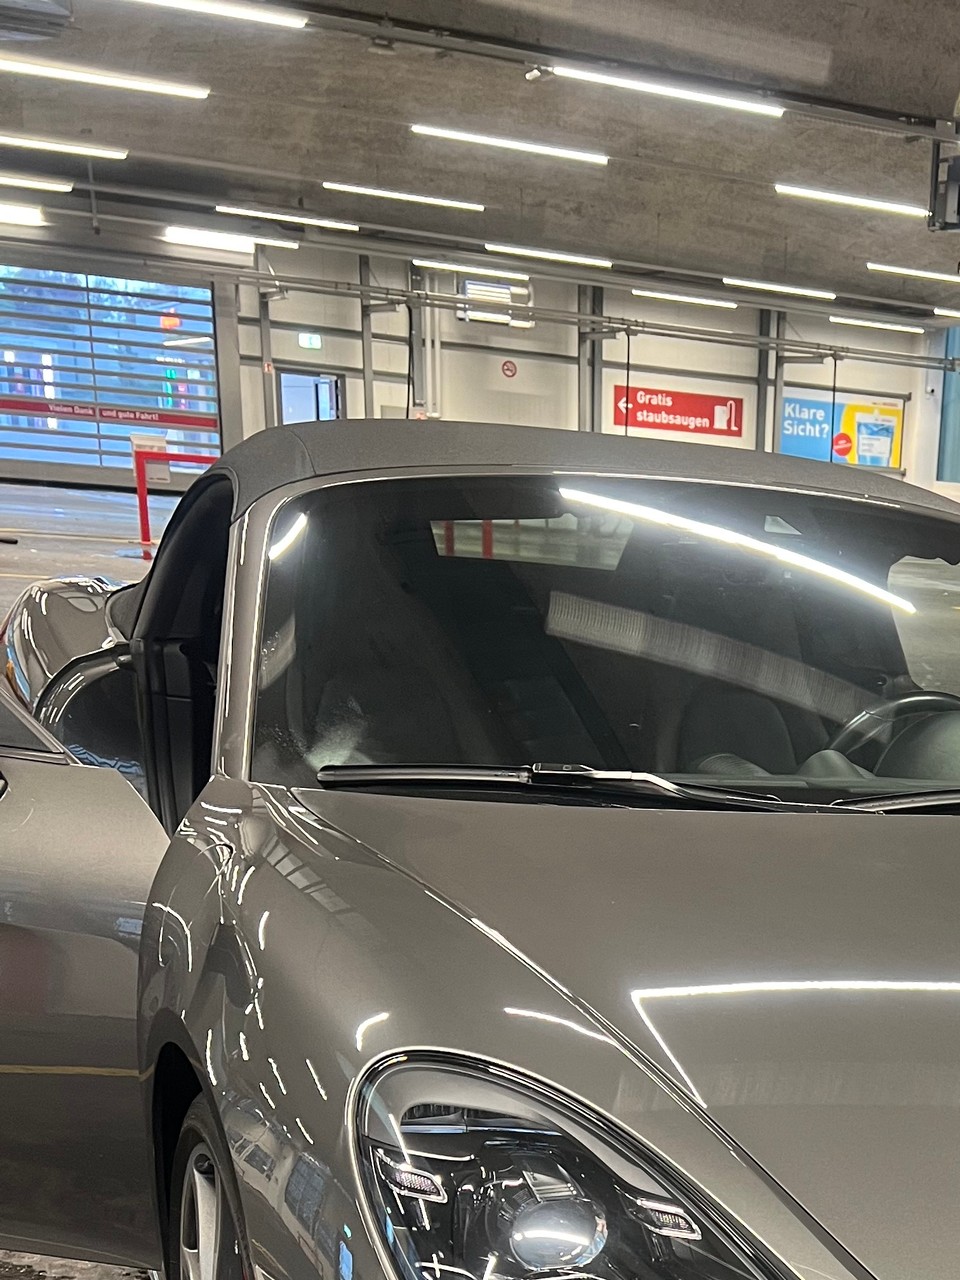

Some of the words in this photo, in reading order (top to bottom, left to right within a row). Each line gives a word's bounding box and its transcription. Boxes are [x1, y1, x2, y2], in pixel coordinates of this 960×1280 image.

[636, 391, 672, 407] Gratis
[49, 404, 73, 413] Vielen
[74, 406, 94, 415] Dank
[102, 409, 117, 417] und
[118, 411, 134, 420] gute
[136, 412, 159, 421] Fahrt!
[636, 409, 710, 429] staubsaugen
[784, 402, 825, 421] Klare
[783, 419, 830, 438] Sicht?
